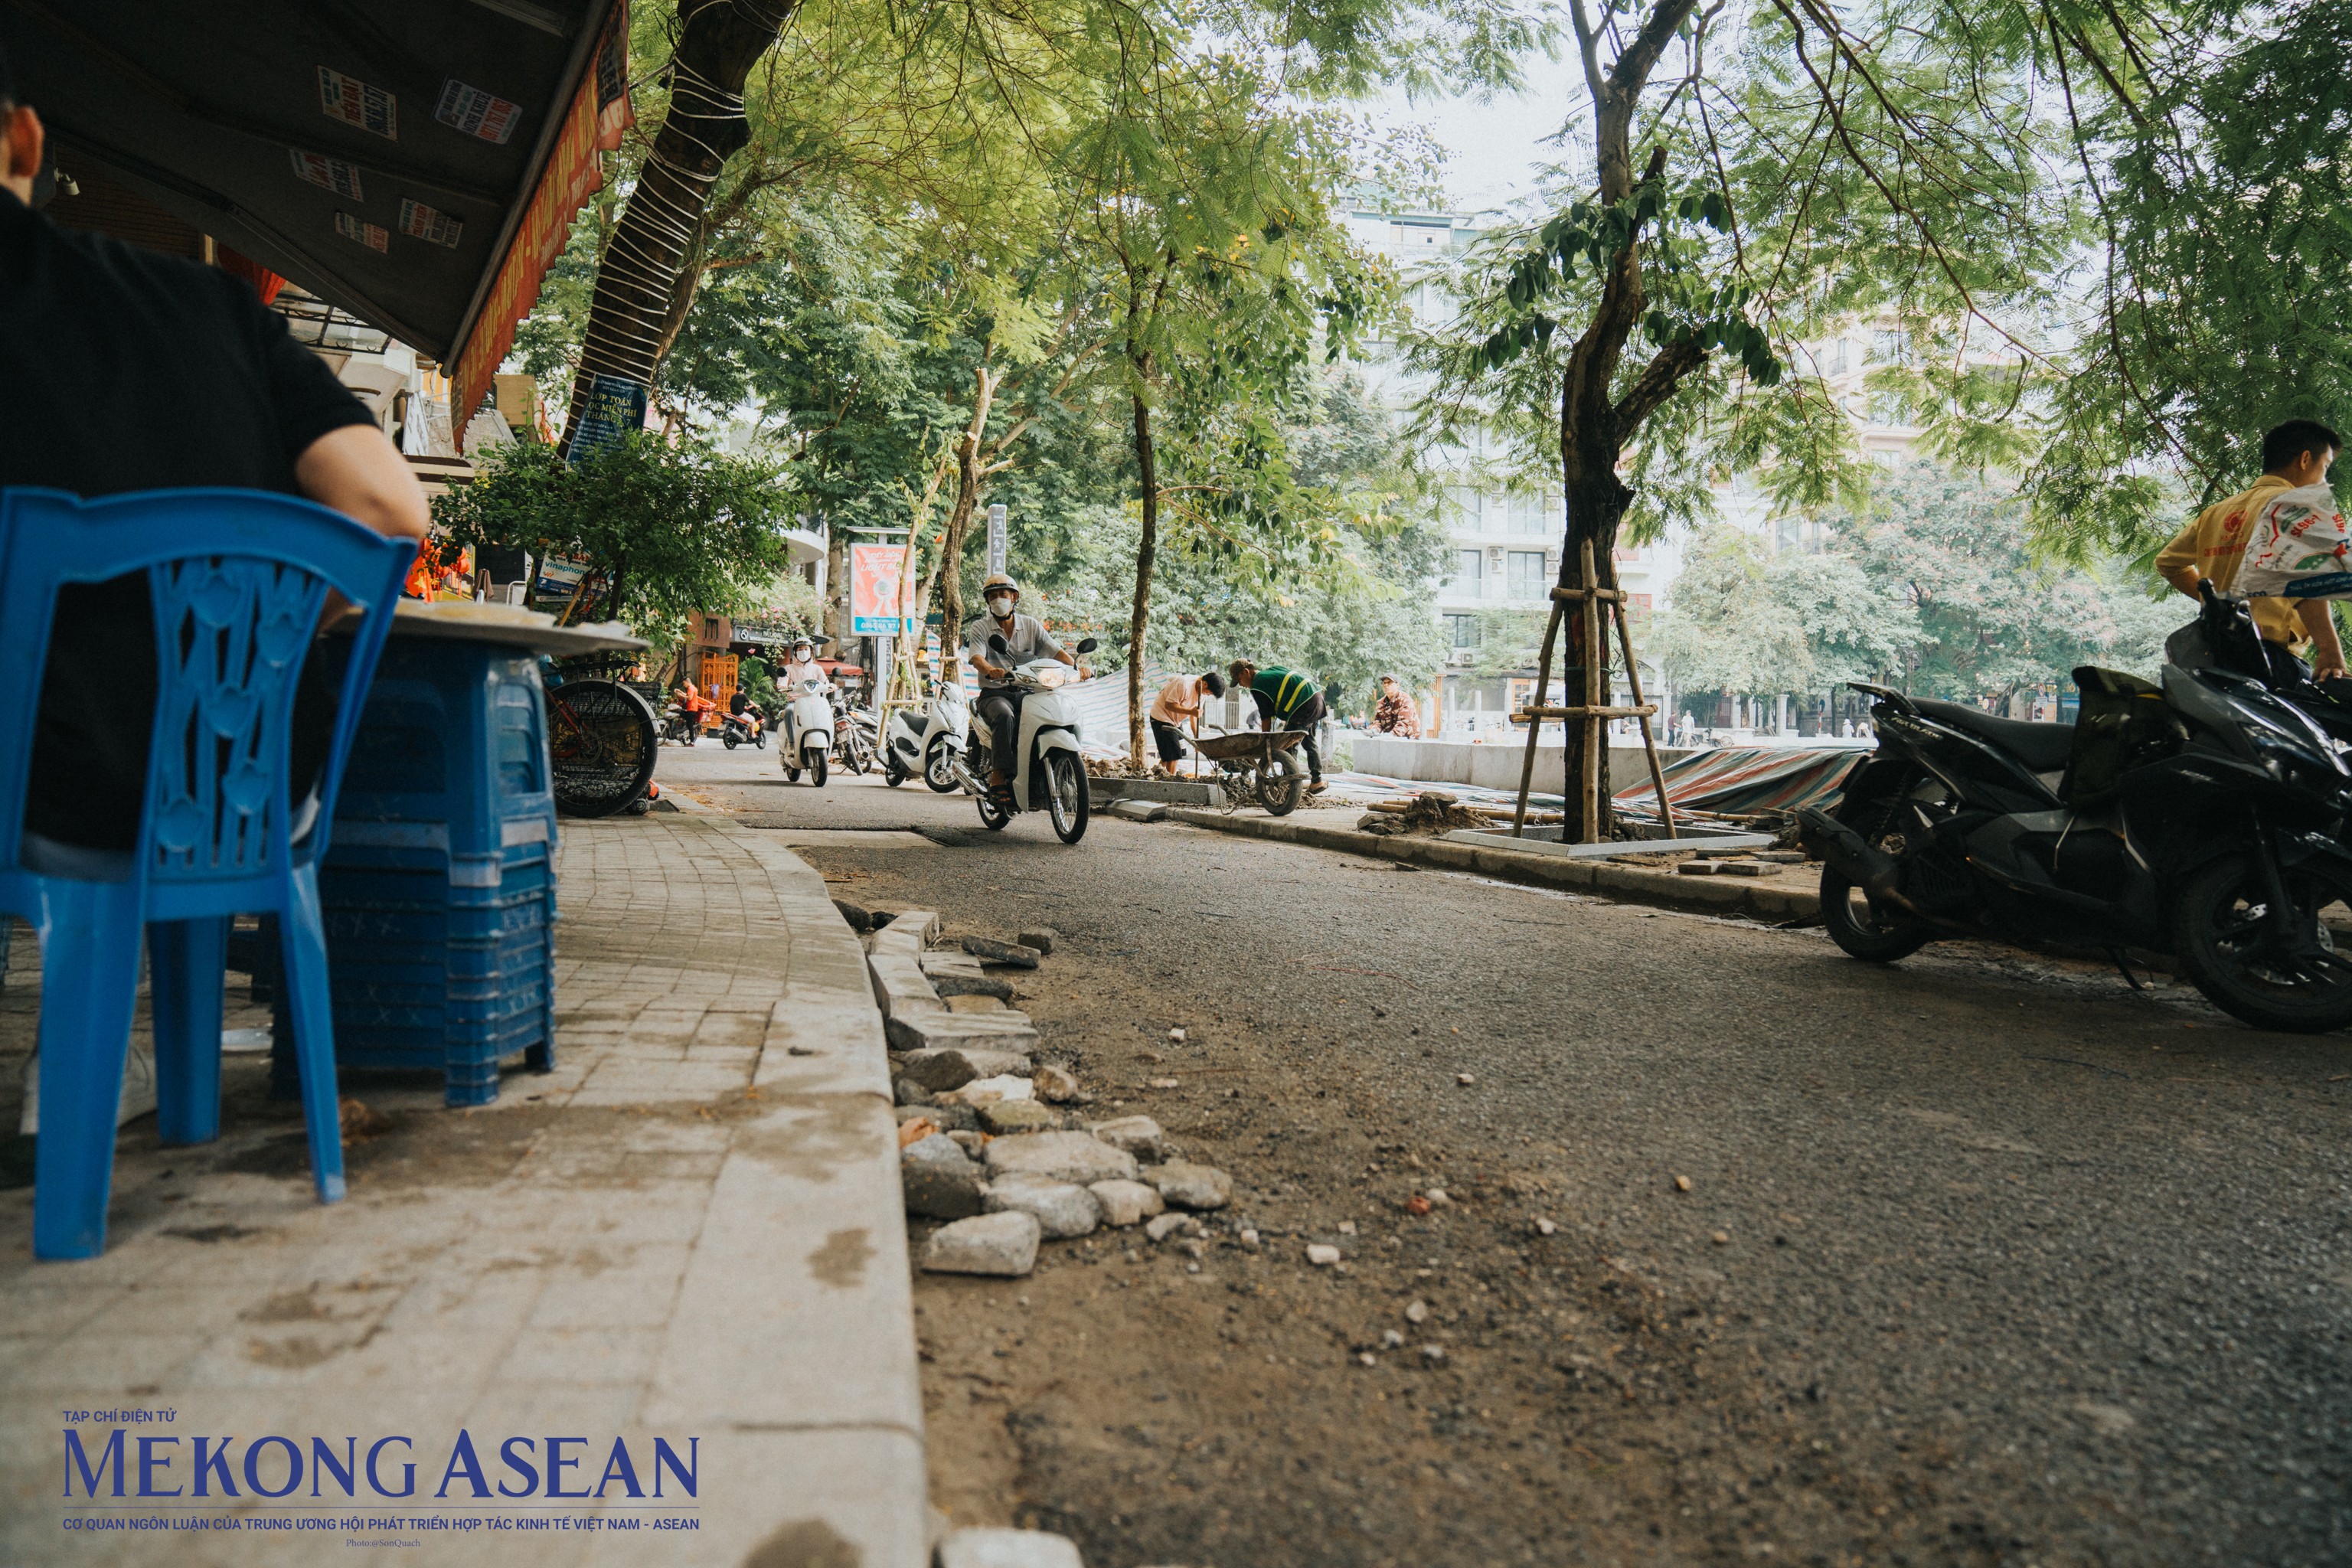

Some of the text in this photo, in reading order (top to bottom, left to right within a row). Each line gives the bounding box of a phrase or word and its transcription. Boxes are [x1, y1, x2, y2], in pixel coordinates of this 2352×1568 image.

[590, 392, 632, 407] LỚP TOÁN
[601, 404, 622, 414] MIỄN
[623, 409, 637, 417] PHÍ
[861, 564, 886, 572] LIGHT
